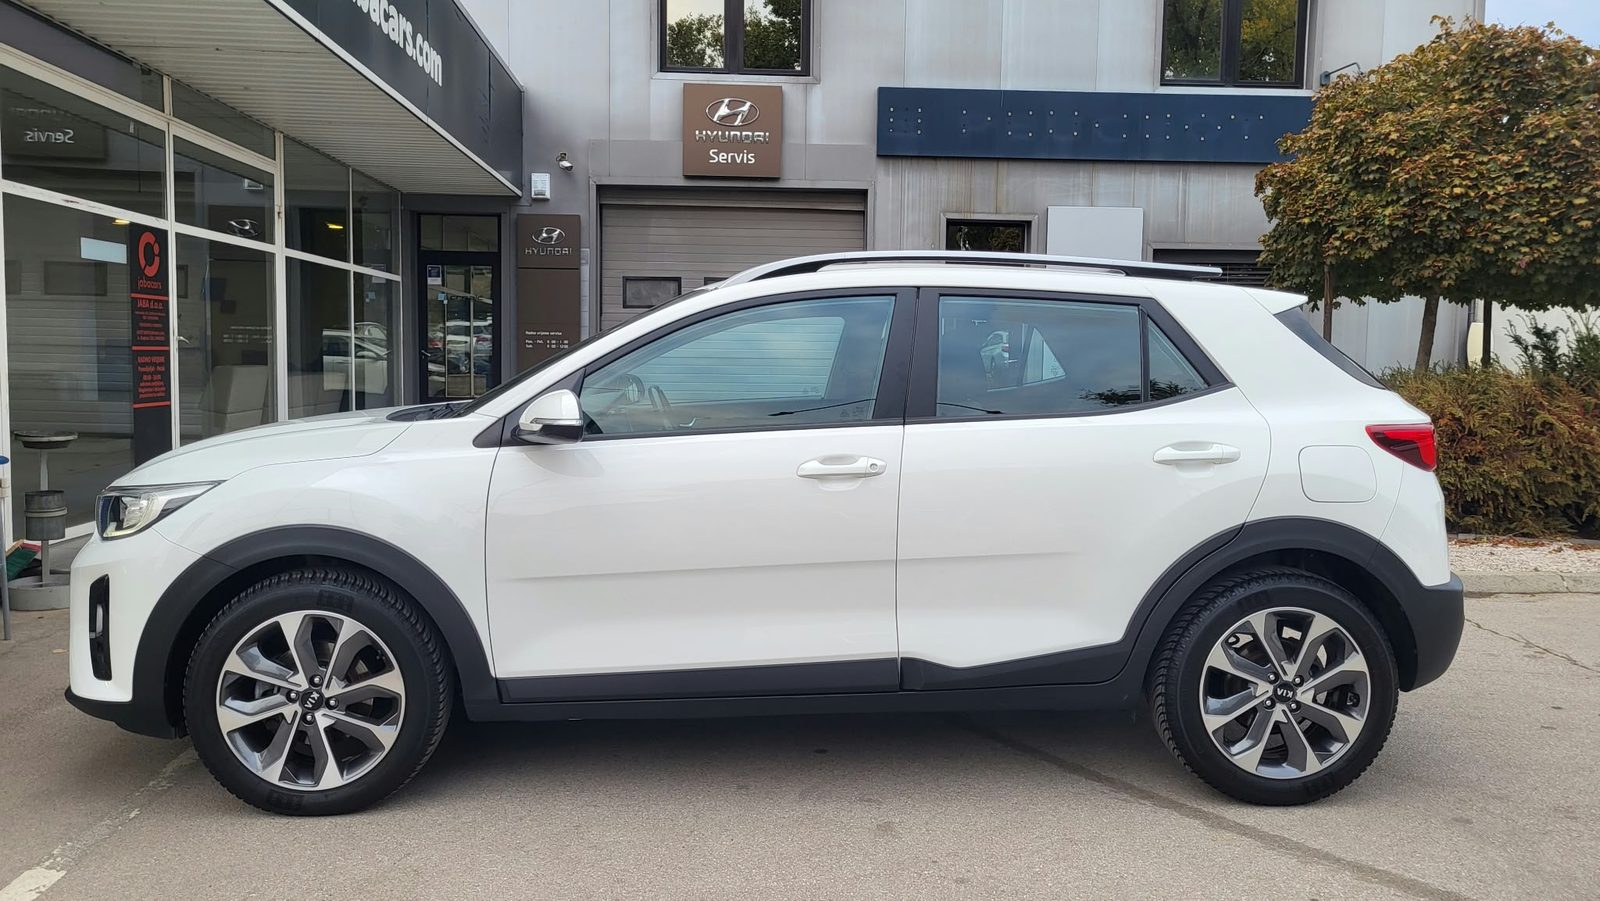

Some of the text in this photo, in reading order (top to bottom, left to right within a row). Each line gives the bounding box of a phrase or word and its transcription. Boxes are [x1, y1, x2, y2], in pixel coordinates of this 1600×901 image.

[353, 0, 443, 87] acars.com
[695, 130, 769, 143] HYUNDAI
[708, 148, 756, 164] Servis
[524, 247, 573, 256] HYUNDAI
[304, 691, 320, 708] KIA
[1276, 687, 1294, 699] KIA
